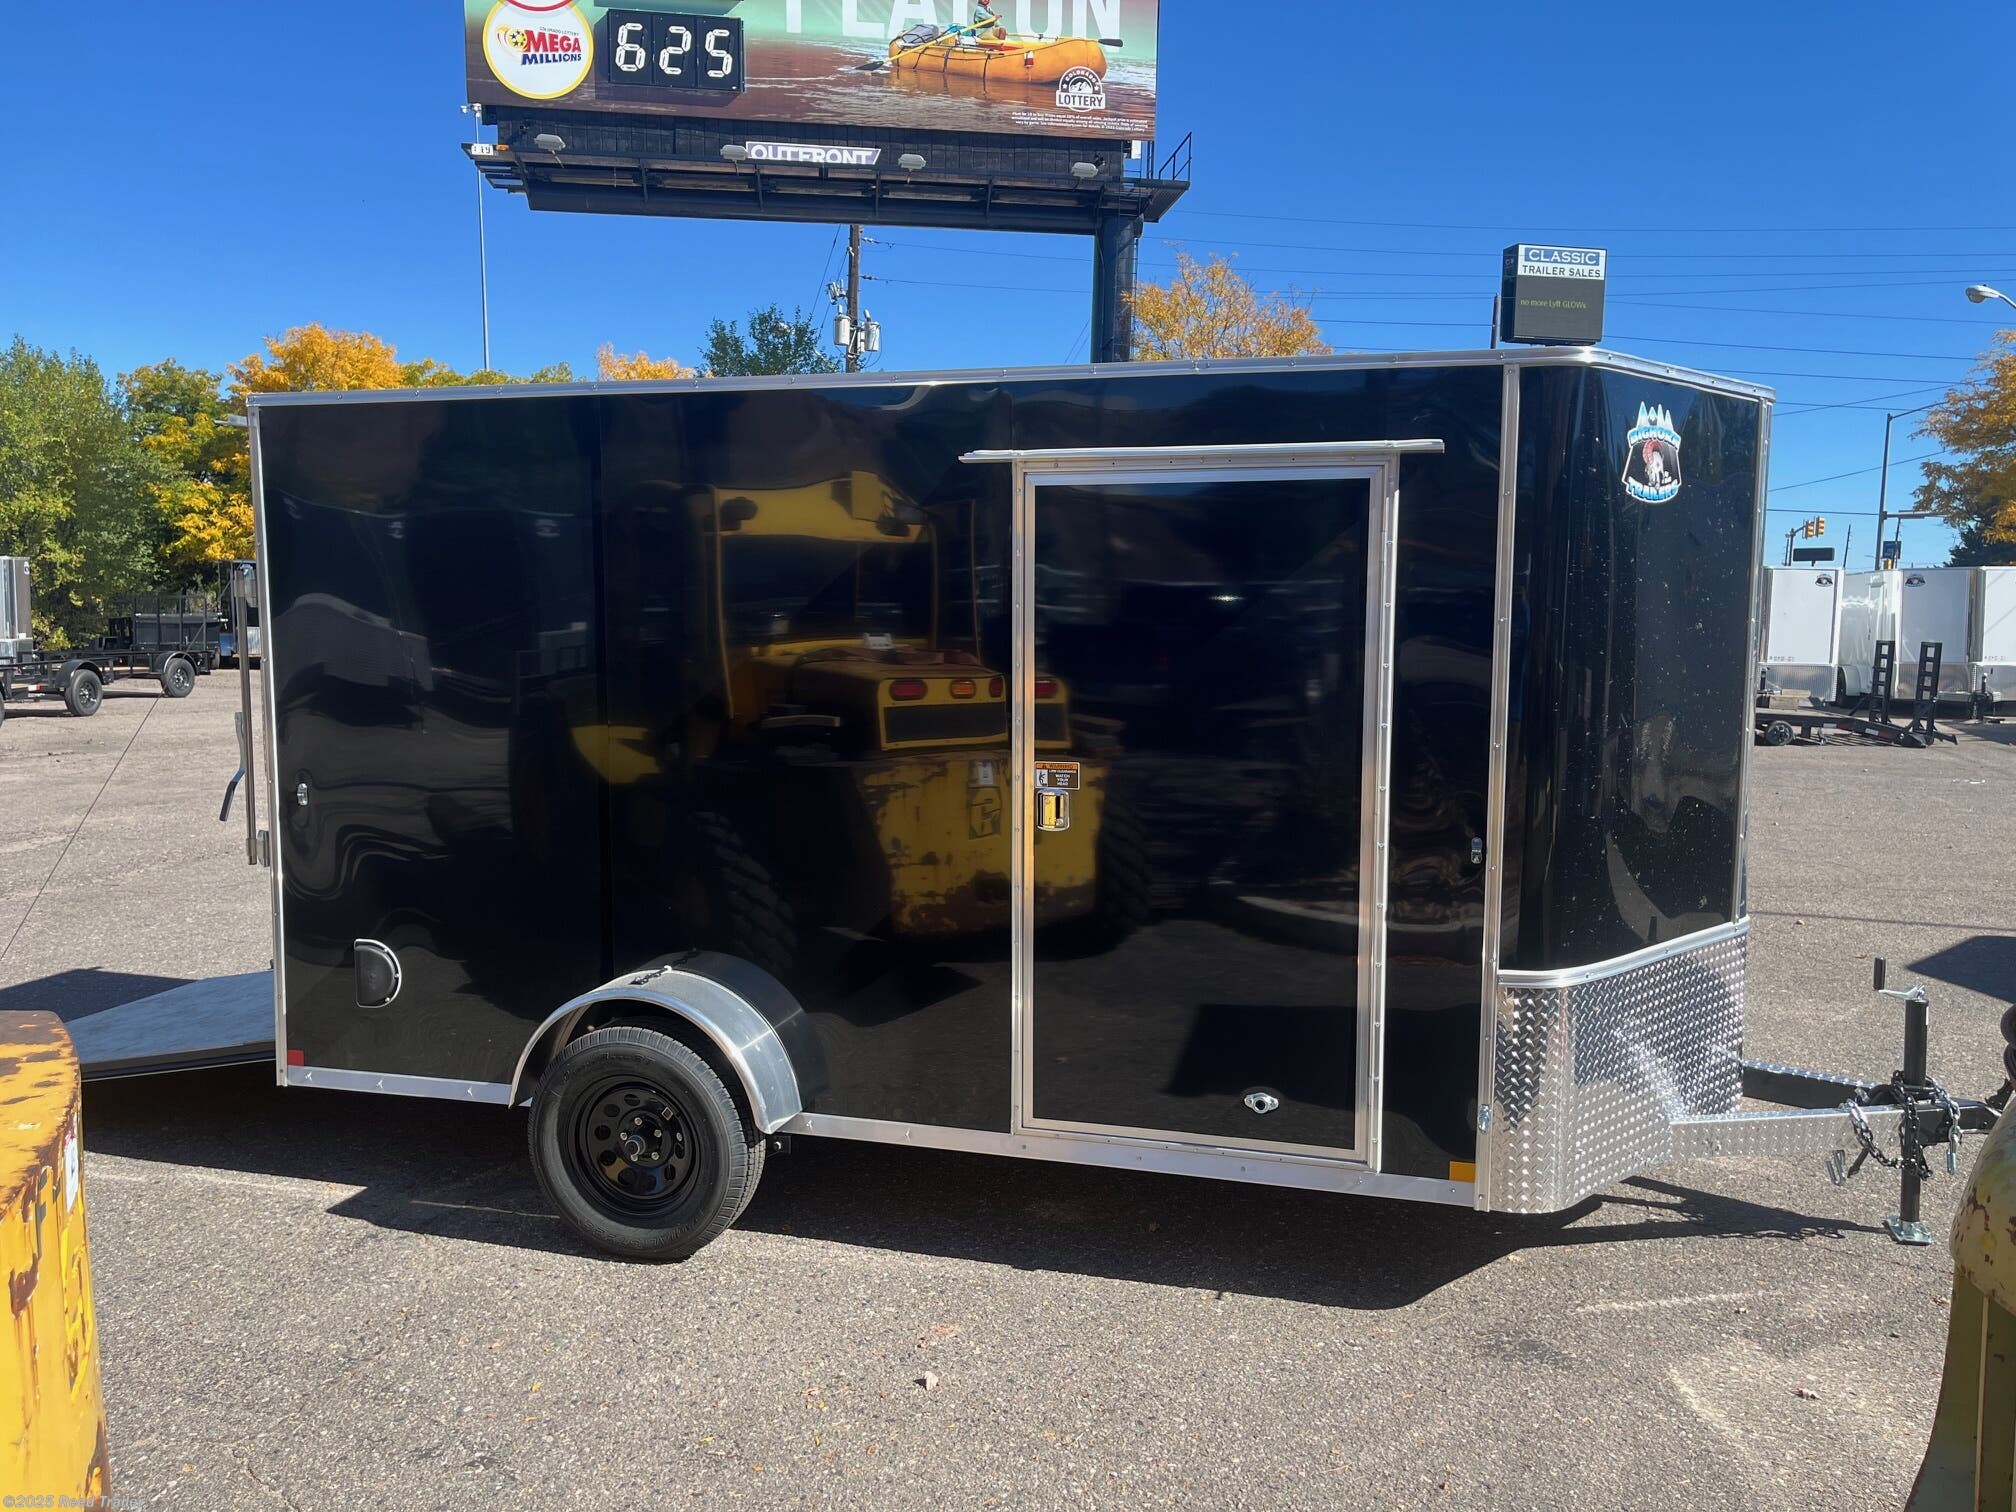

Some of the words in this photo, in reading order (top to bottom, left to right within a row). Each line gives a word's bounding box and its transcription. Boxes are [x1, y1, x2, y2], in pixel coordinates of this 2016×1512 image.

[524, 29, 582, 53] MEGA
[615, 22, 733, 78] 625
[521, 53, 582, 65] MILLIONS
[1065, 69, 1097, 83] COLORADO
[1058, 94, 1103, 107] LOTTERY
[751, 144, 873, 165] OUTFRONT
[1528, 250, 1596, 264] CLASSIC
[1522, 265, 1566, 276] TRAILER
[1569, 268, 1600, 278] SALES
